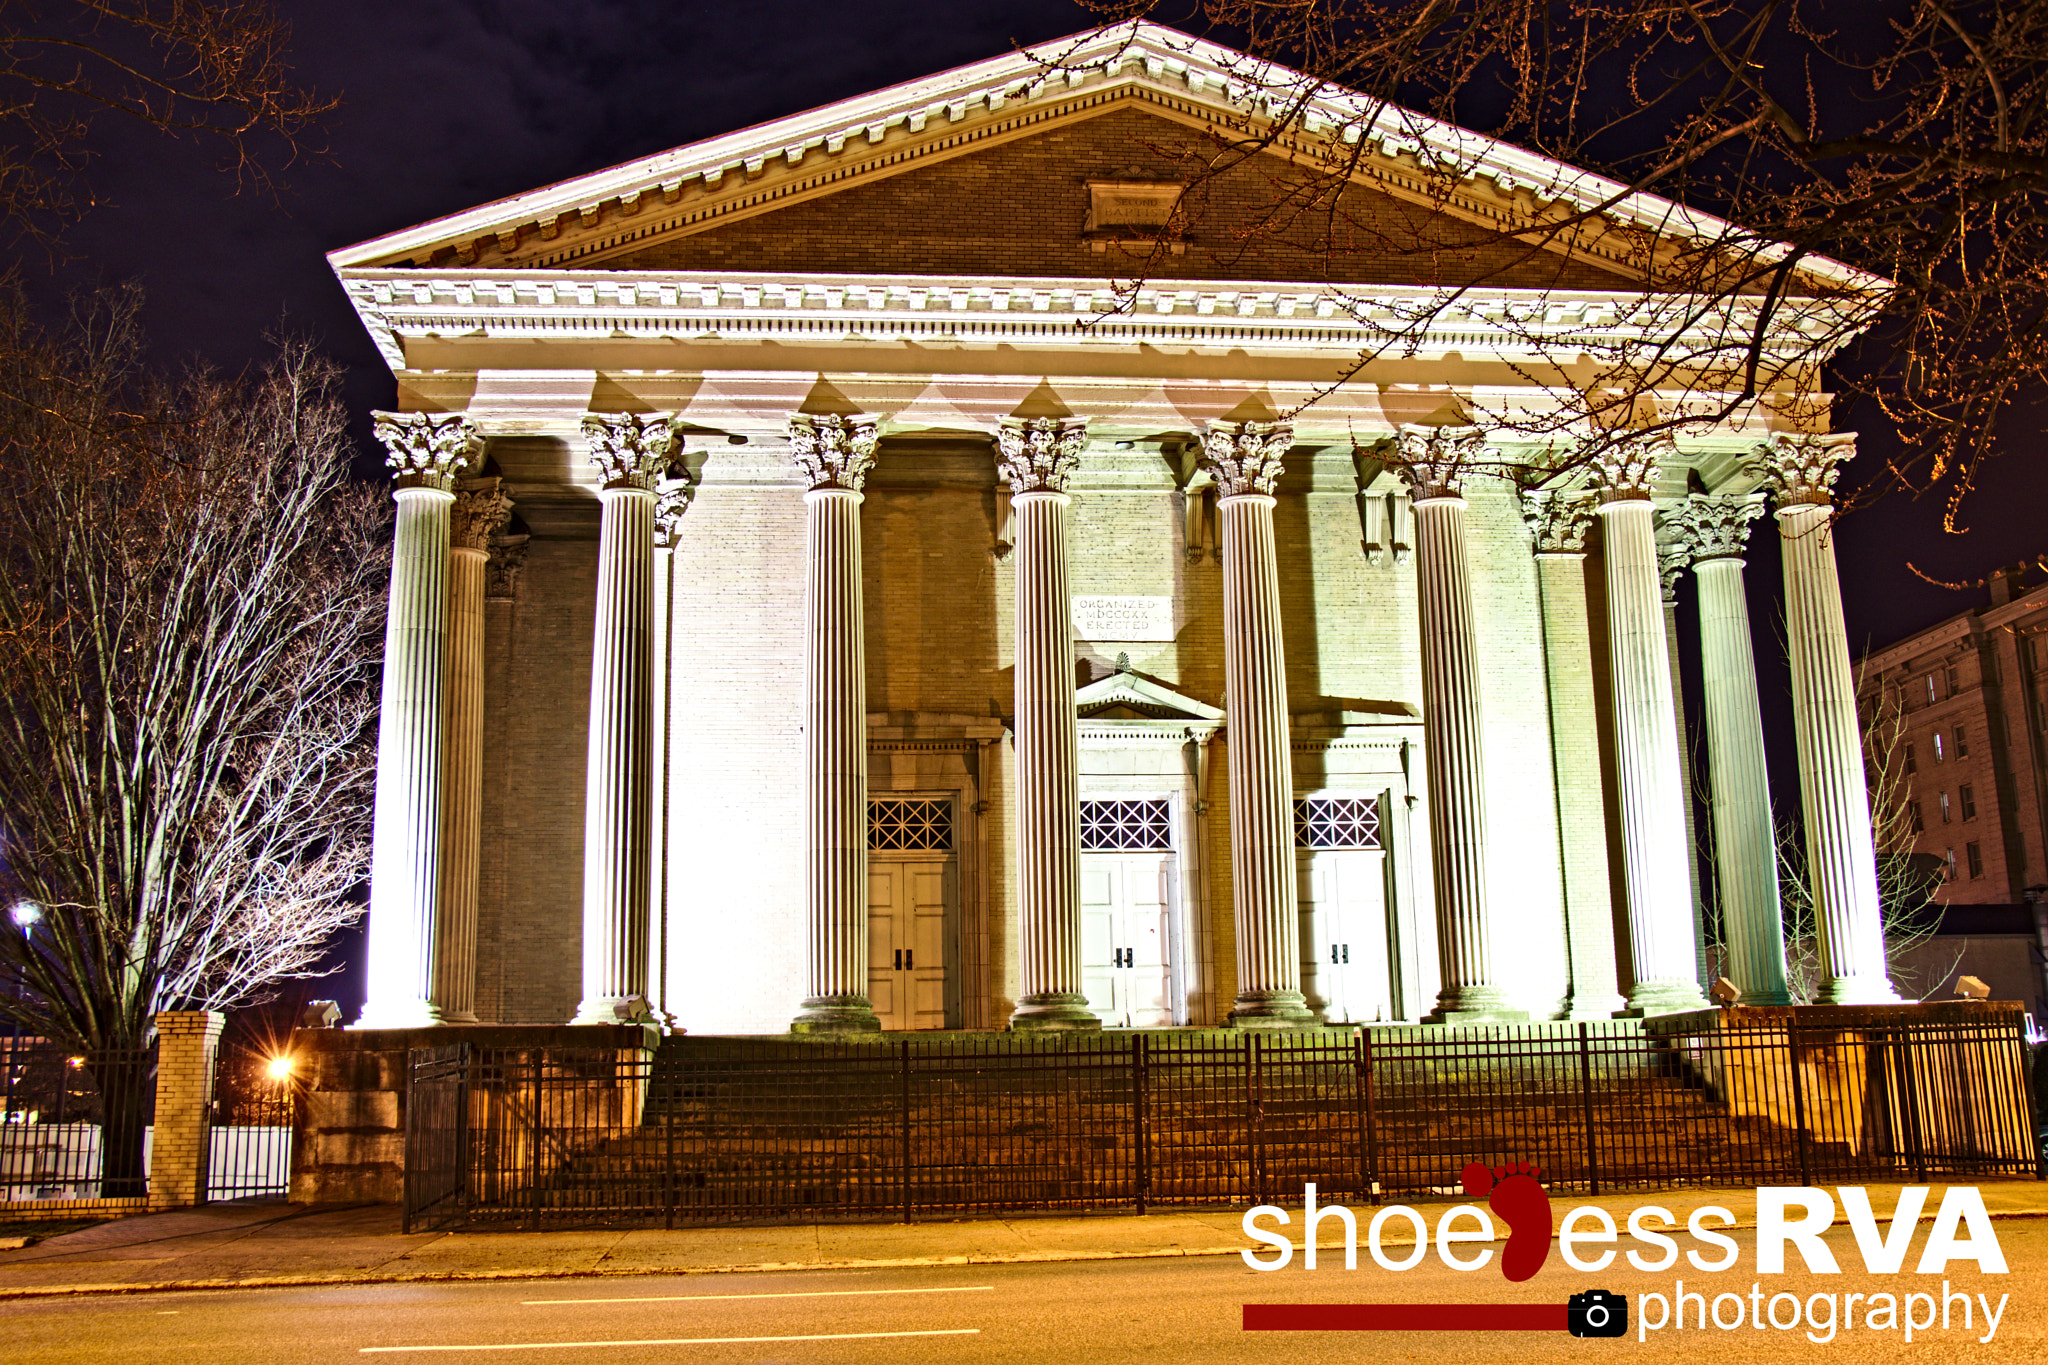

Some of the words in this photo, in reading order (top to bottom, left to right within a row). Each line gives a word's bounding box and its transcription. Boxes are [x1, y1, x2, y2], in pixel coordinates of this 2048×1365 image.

[1116, 199, 1158, 207] SECOND
[1105, 208, 1167, 217] BAPTIST
[1116, 218, 1158, 226] CHURCH
[1079, 600, 1155, 609] ORGANIZED
[1086, 609, 1149, 619] MDCCCXX
[1086, 621, 1149, 630] ERECTED
